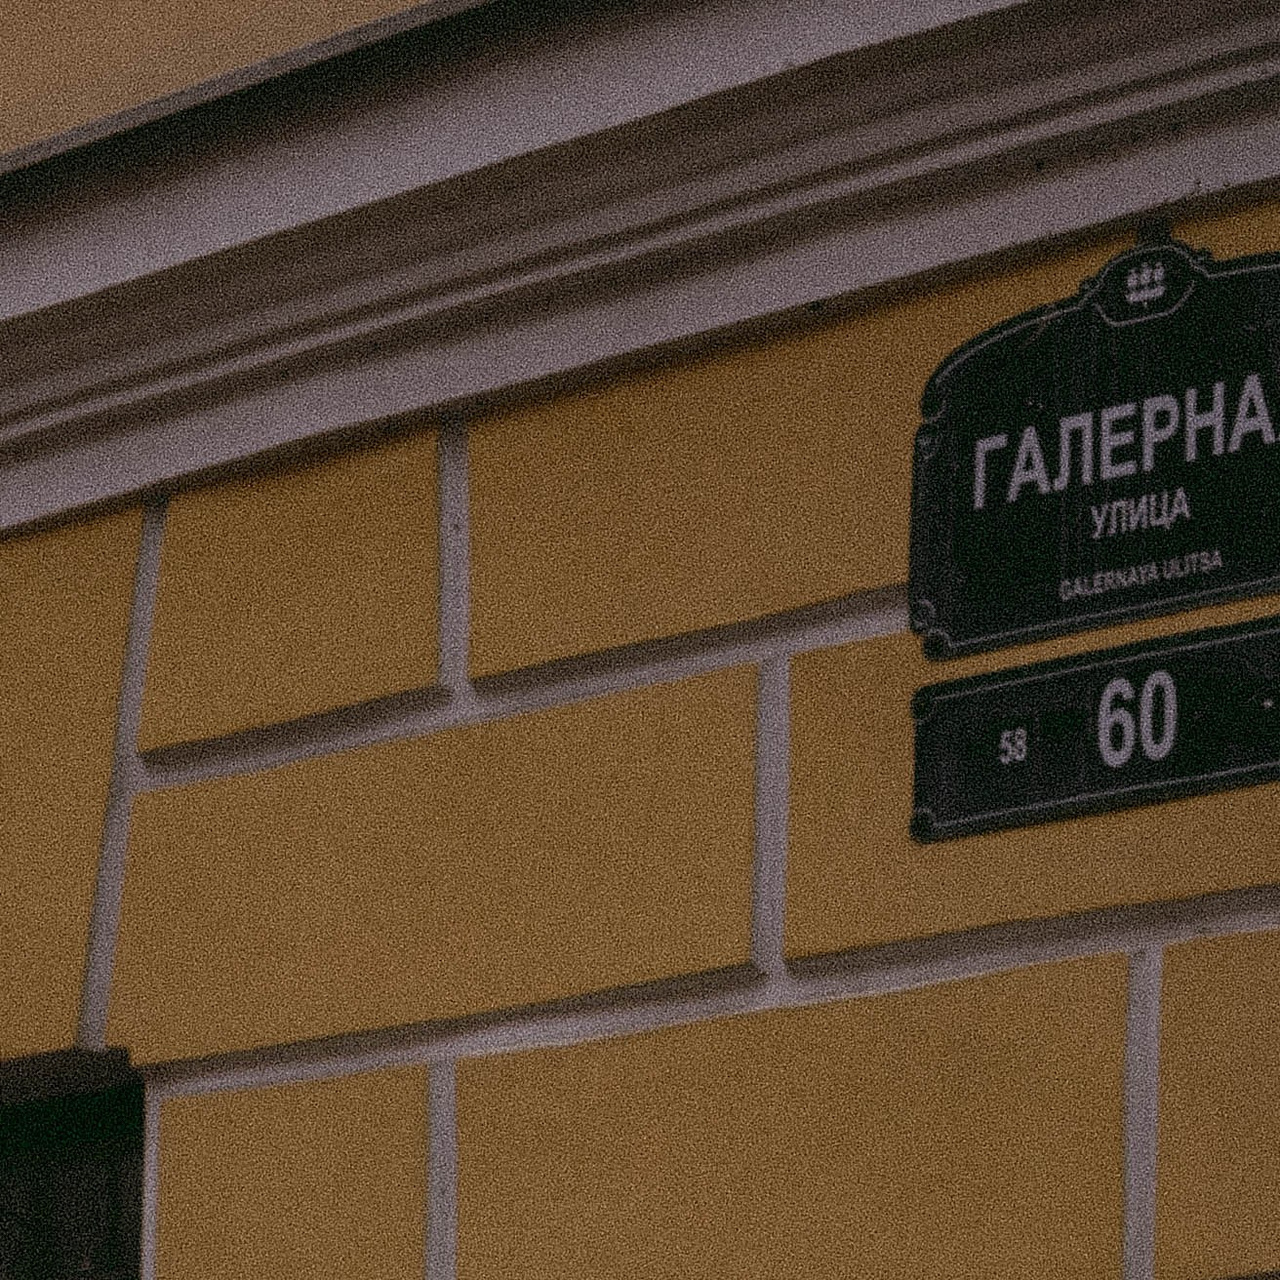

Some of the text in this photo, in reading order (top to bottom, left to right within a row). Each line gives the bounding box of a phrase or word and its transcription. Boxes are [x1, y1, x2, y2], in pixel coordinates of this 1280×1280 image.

[974, 373, 1280, 510] ГАЛЕРНА
[1090, 486, 1192, 539] УЛИЦА
[1059, 549, 1224, 601] GALERNAYA ULITSA
[997, 727, 1028, 765] 58
[1097, 670, 1179, 769] 60
